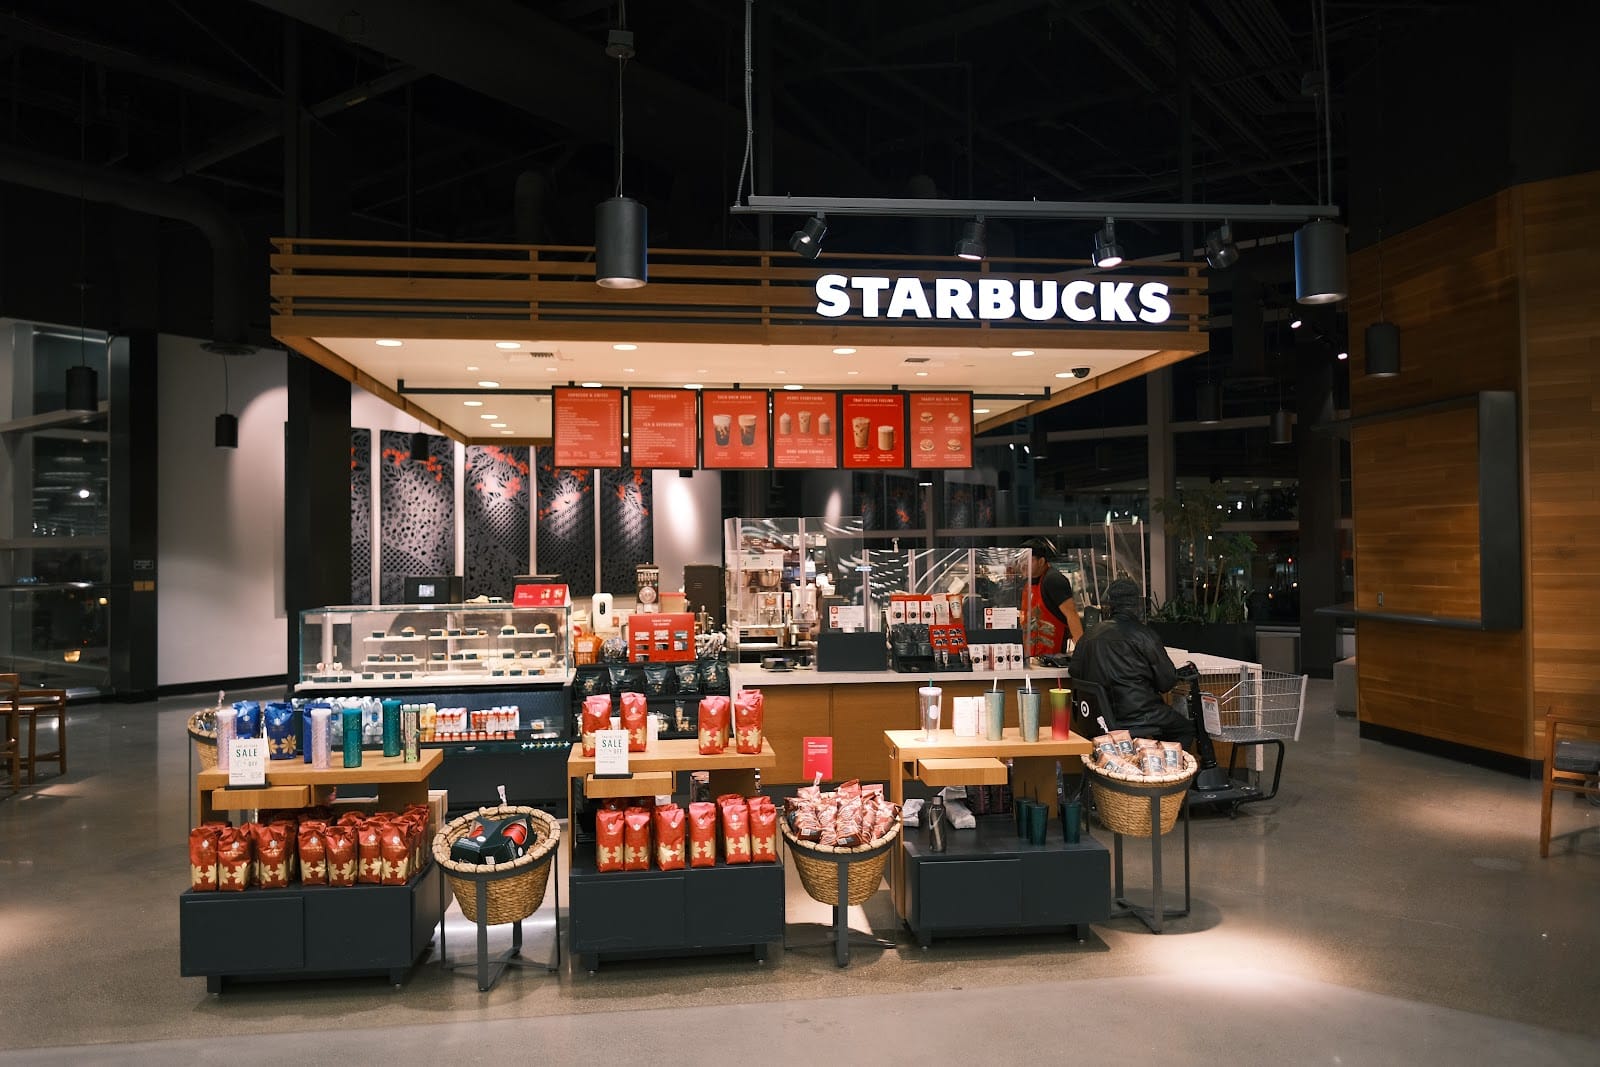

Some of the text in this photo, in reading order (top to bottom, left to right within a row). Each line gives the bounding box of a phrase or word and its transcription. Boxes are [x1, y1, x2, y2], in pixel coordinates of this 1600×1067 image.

[815, 274, 1171, 323] STARBUCKS
[602, 739, 622, 748] SALE
[236, 749, 257, 758] SALE
